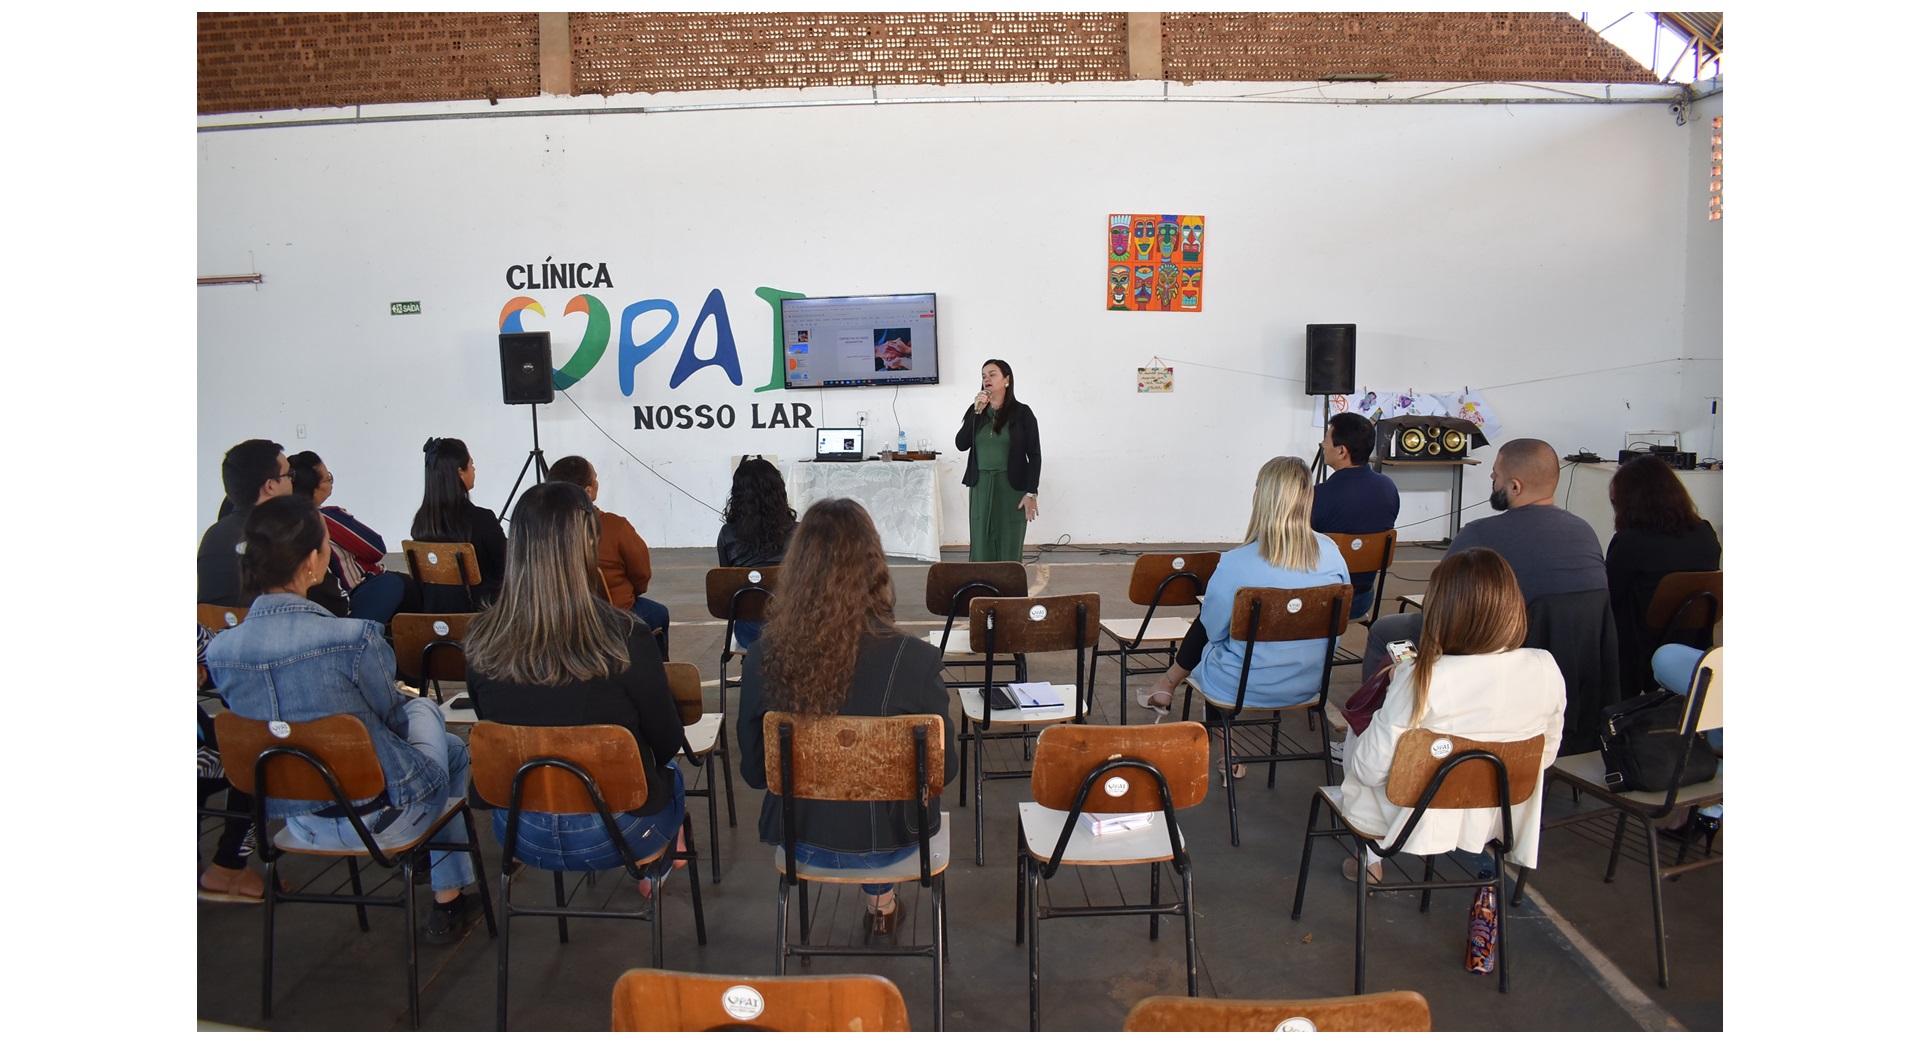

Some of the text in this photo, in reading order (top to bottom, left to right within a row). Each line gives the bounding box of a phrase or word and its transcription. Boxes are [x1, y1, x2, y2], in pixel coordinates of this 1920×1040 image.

[506, 255, 614, 290] CLÍNICA
[633, 403, 815, 430] NOSSO LAR
